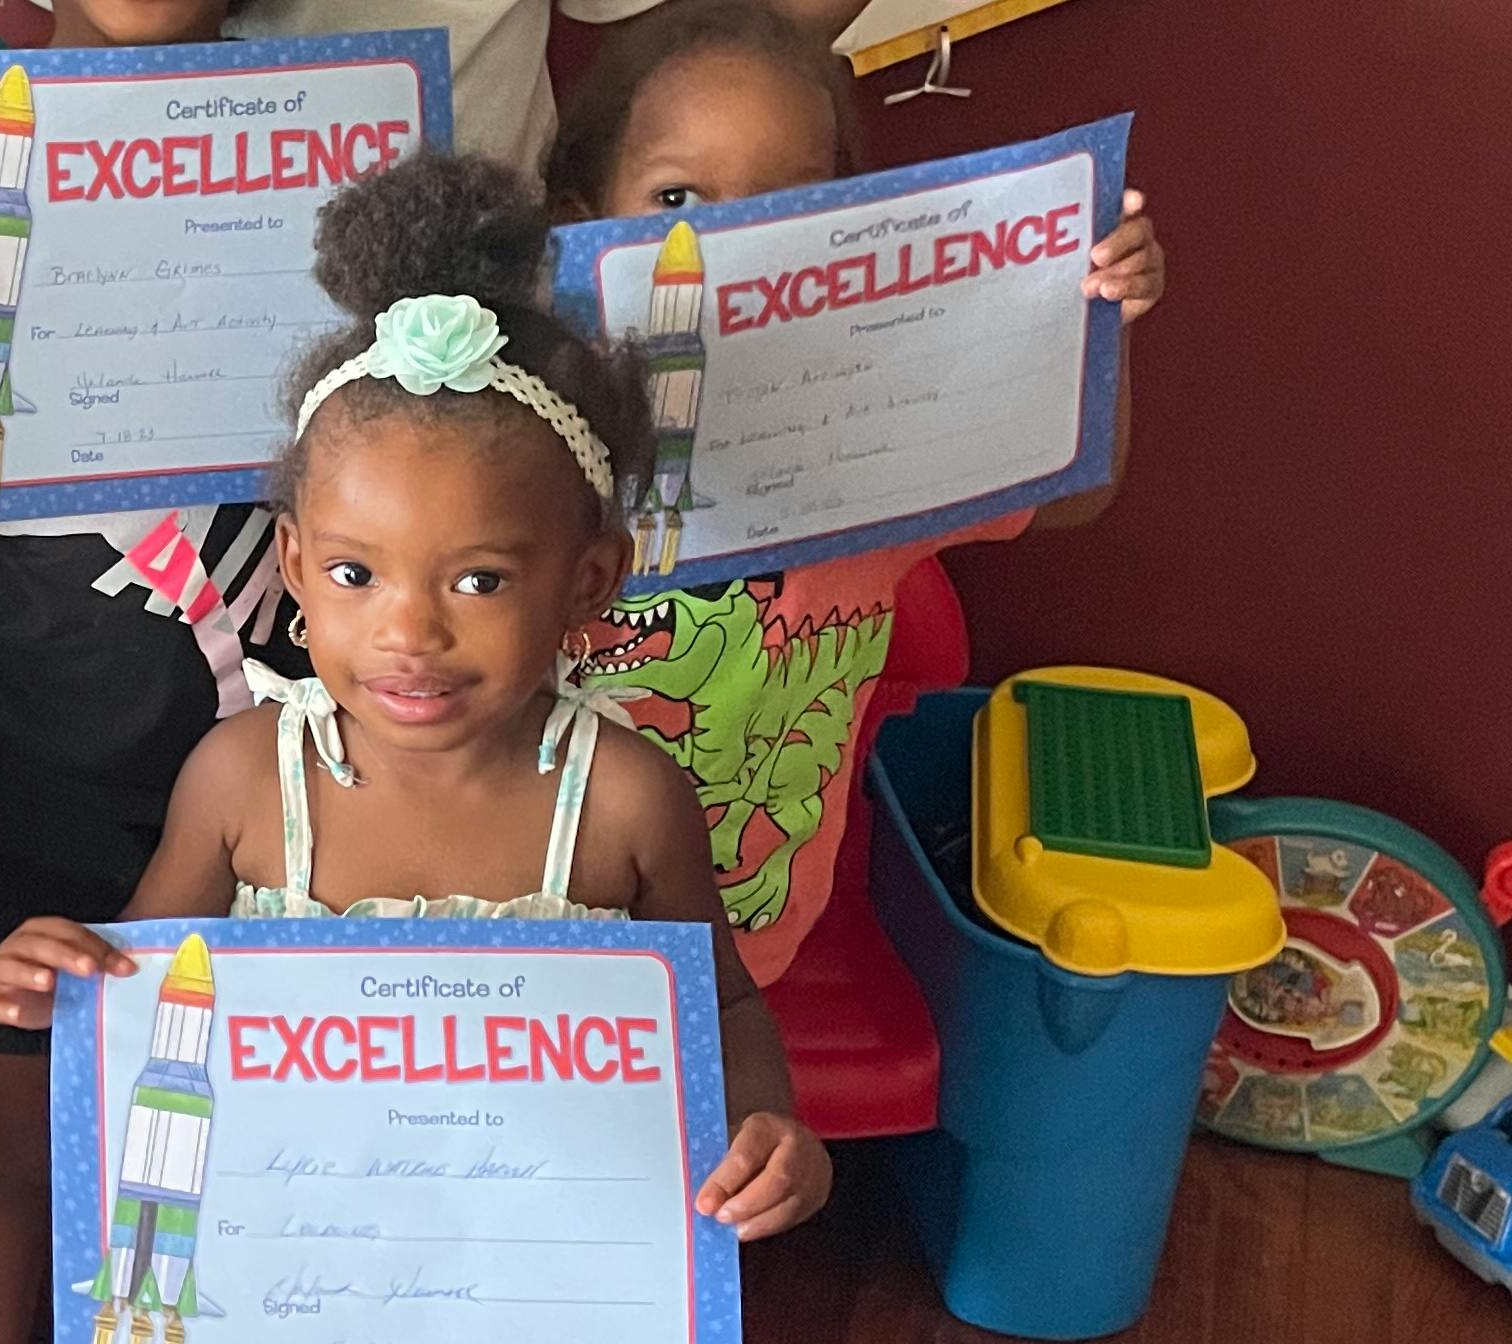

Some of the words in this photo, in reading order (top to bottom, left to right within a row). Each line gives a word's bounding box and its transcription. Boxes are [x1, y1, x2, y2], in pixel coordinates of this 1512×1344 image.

[166, 96, 277, 121] Certificate
[283, 90, 307, 113] of
[45, 119, 410, 204] EXCELLENCE
[184, 215, 263, 235] Presented
[266, 215, 285, 231] to
[830, 212, 942, 249] Certificate
[947, 199, 974, 222] of
[715, 202, 1082, 339] EXCELLENCE
[30, 325, 57, 341] For
[849, 309, 927, 338] Presented
[928, 306, 947, 324] to
[69, 388, 121, 411] Signed
[70, 448, 105, 464] Date
[709, 438, 732, 453] For
[745, 474, 795, 498] Signed
[747, 524, 780, 541] Date
[360, 976, 491, 999] Certificate
[498, 976, 527, 999] of
[226, 1013, 662, 1085] EXCELLENCE
[387, 1109, 480, 1128] Presented
[485, 1110, 506, 1128] to
[217, 1219, 247, 1237] For
[262, 1298, 323, 1320] Signed
